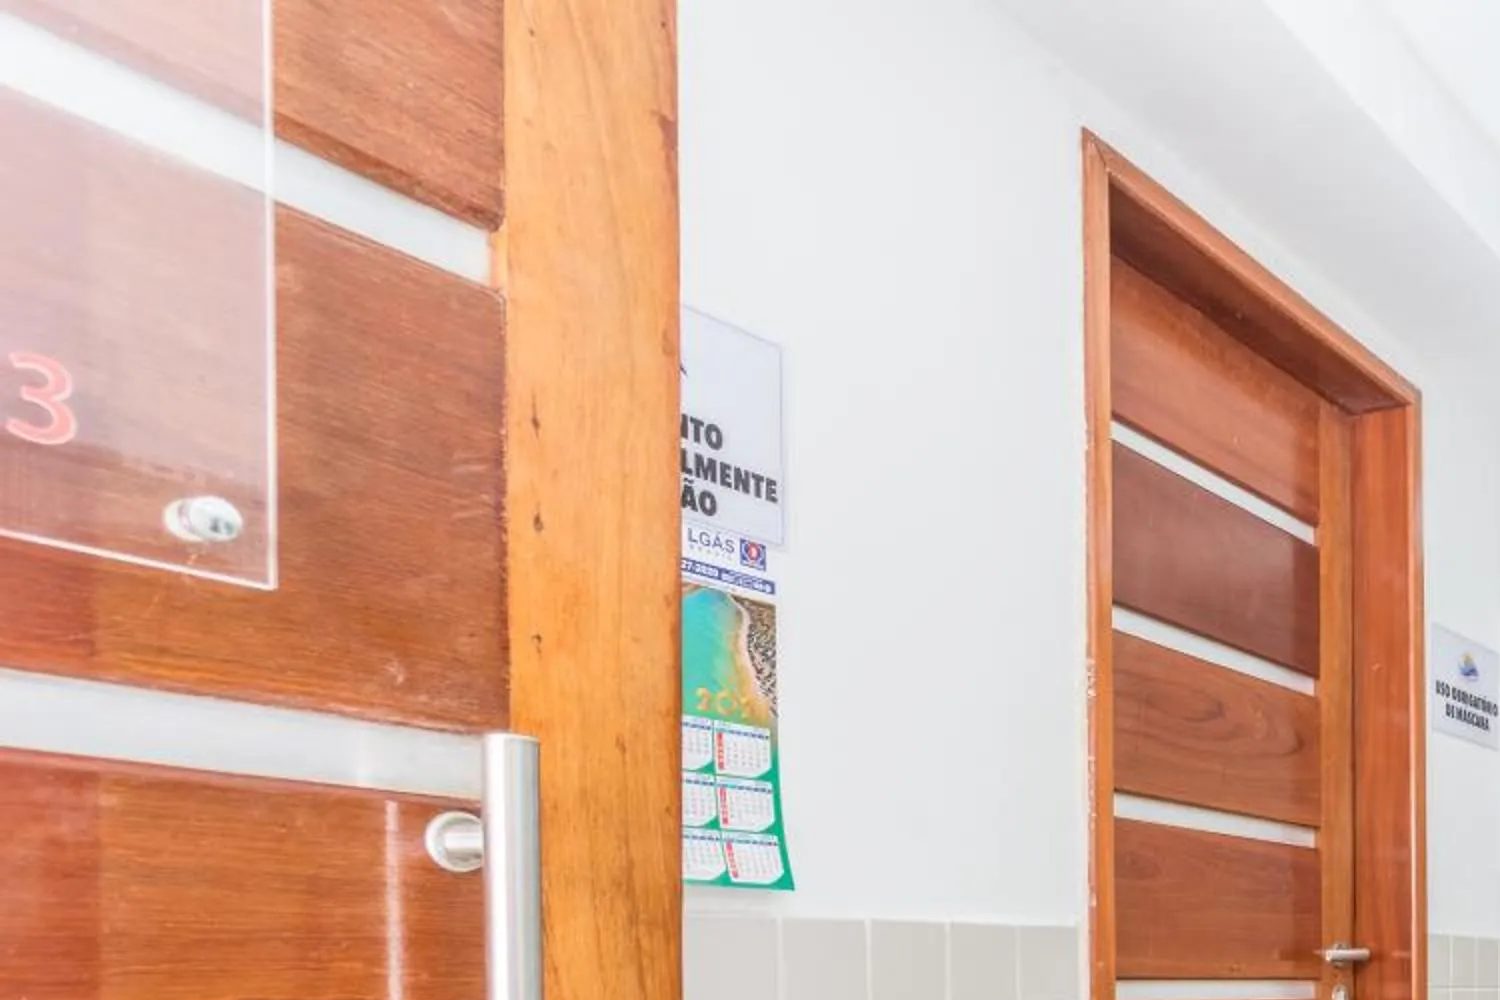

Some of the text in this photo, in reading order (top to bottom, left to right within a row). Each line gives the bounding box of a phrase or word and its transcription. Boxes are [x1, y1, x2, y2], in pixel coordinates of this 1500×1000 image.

[6, 353, 77, 444] 3
[1436, 680, 1450, 698] USO
[1445, 703, 1455, 719] DE
